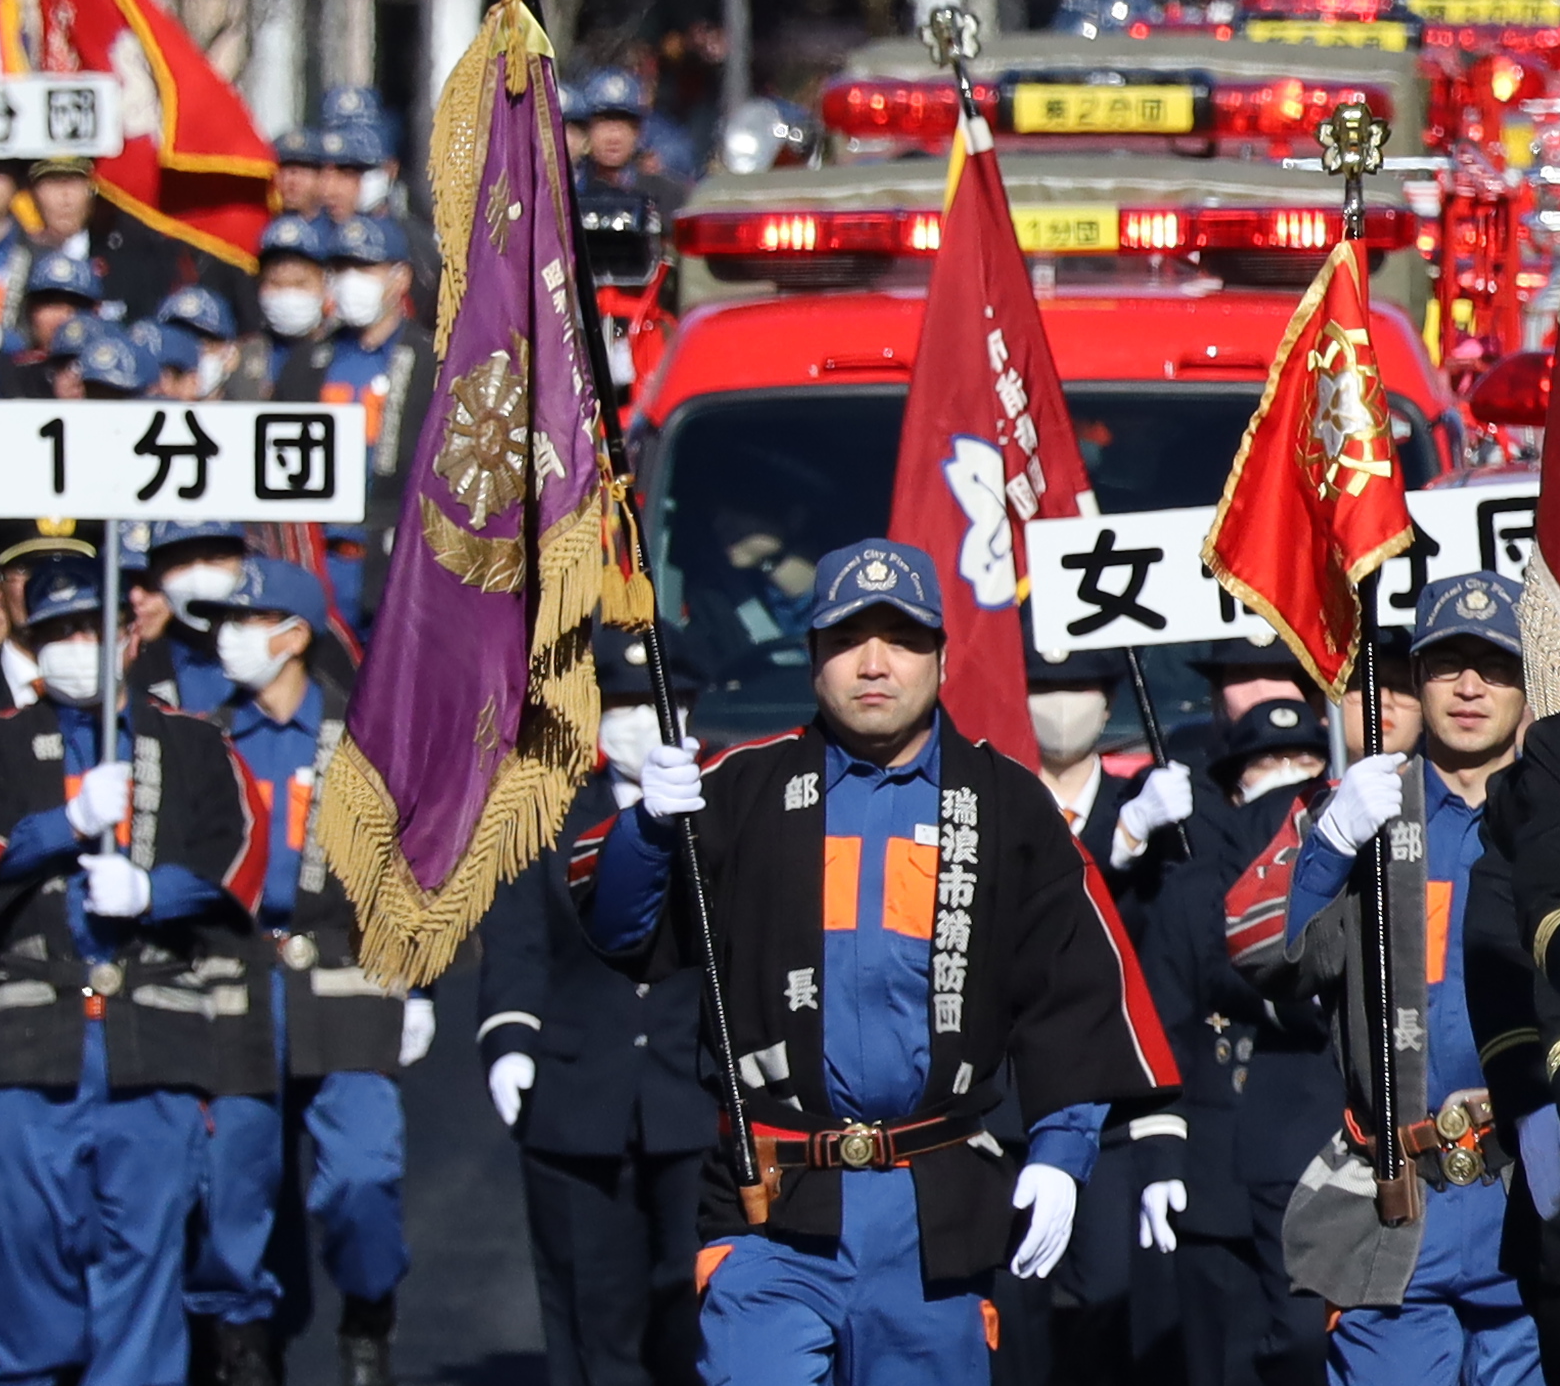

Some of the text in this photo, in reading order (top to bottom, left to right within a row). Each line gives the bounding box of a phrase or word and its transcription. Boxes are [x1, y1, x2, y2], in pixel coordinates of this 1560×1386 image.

[1024, 217, 1100, 246] 1分団
[863, 549, 887, 561] City
[889, 552, 911, 573] Fire
[933, 786, 980, 1033] 瑞浪市消防団
